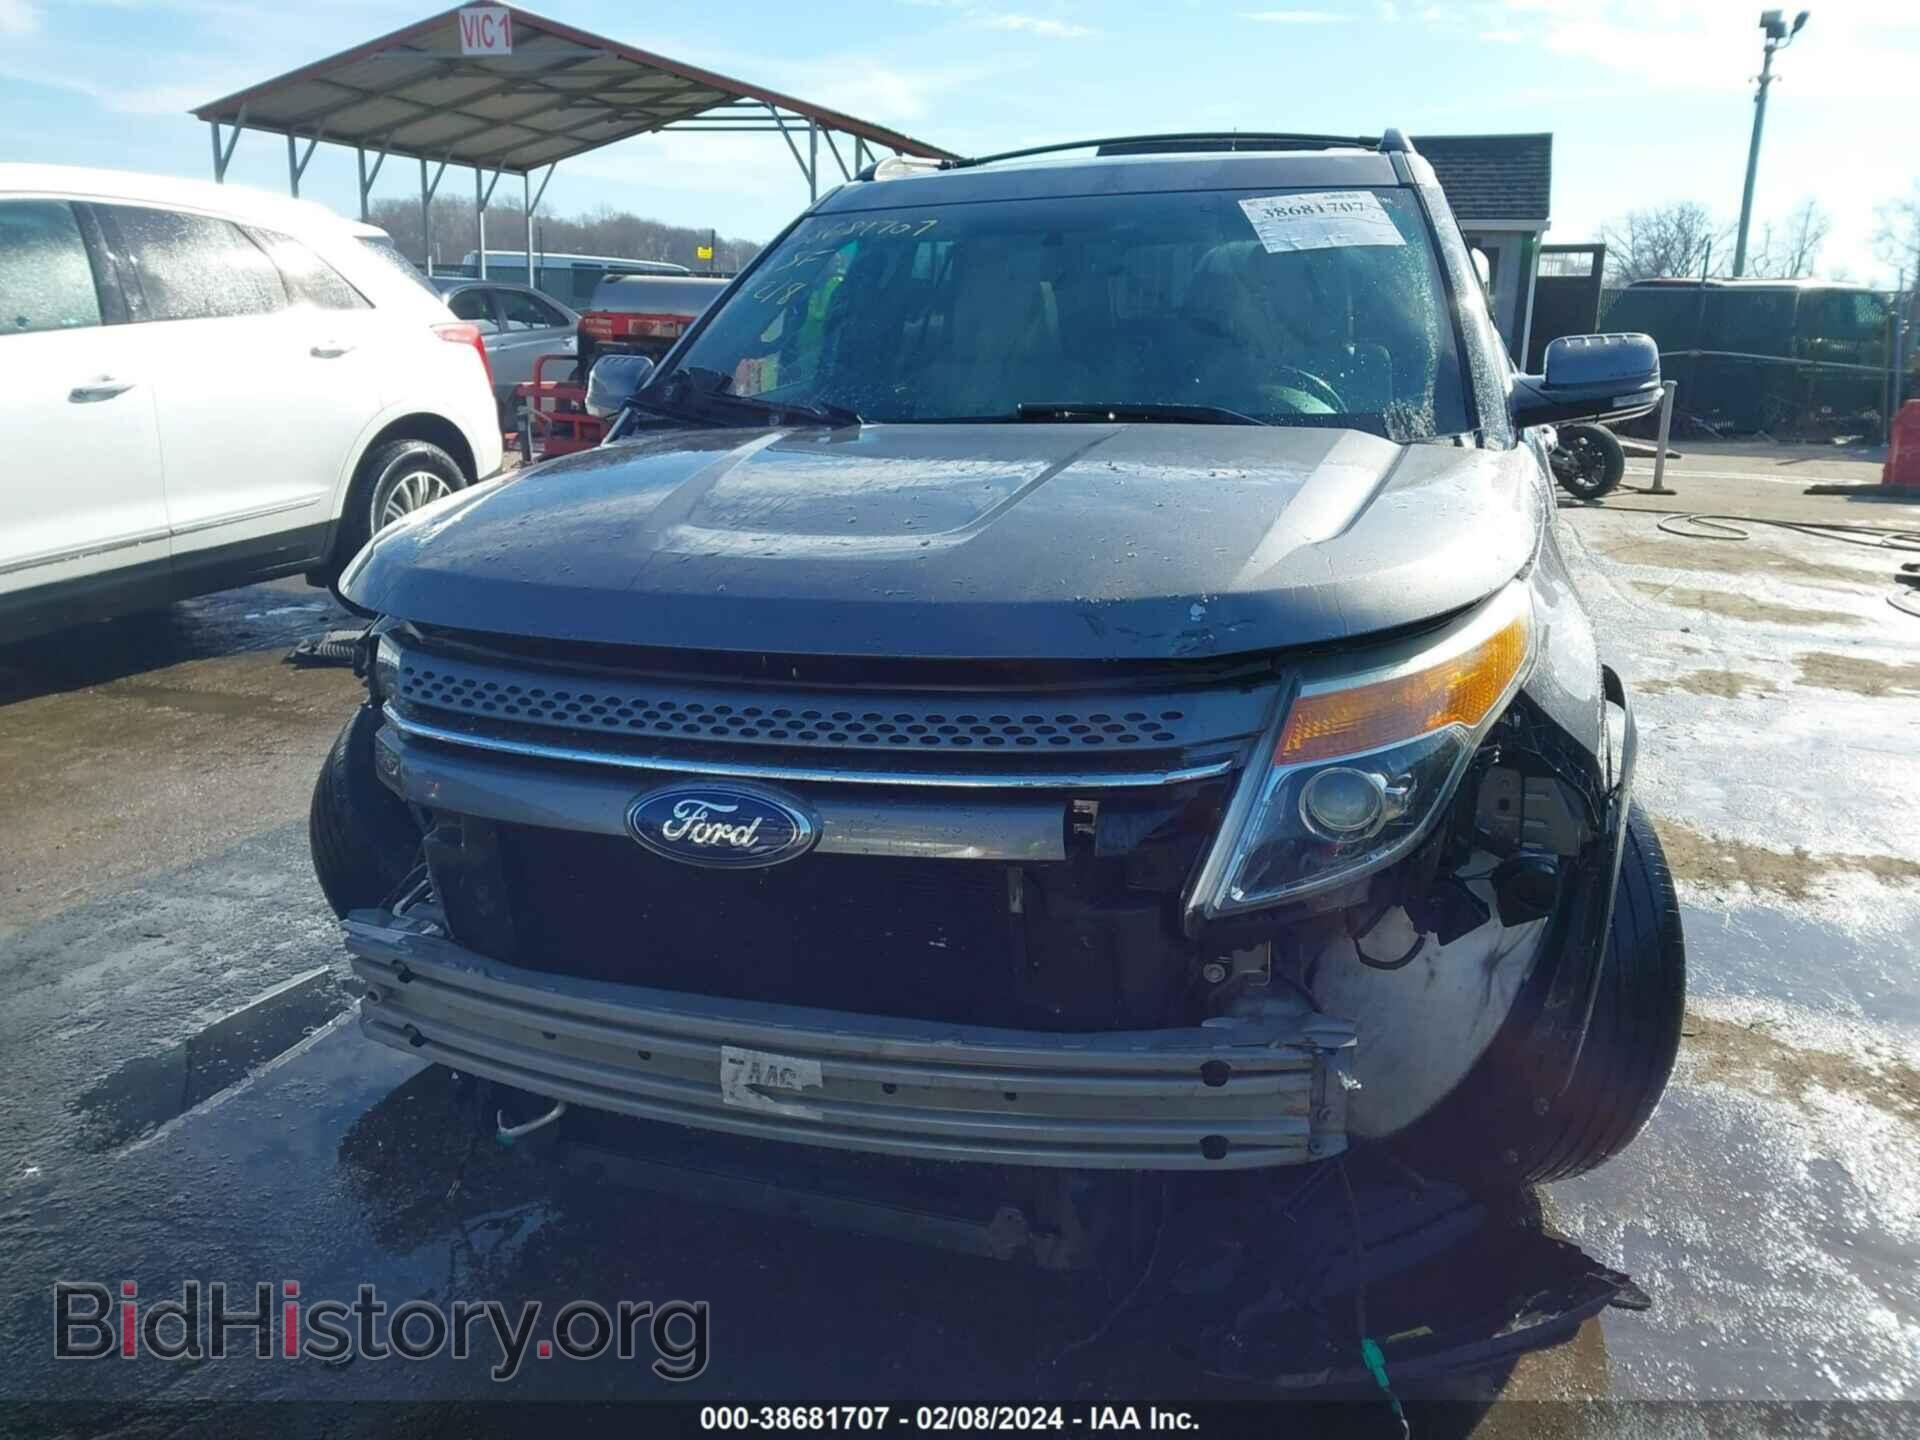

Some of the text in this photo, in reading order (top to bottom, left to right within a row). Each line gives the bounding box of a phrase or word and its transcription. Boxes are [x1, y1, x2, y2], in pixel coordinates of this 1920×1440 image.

[460, 13, 511, 48] VIC 1
[1263, 201, 1364, 219] 38681707
[662, 799, 762, 848] Ford
